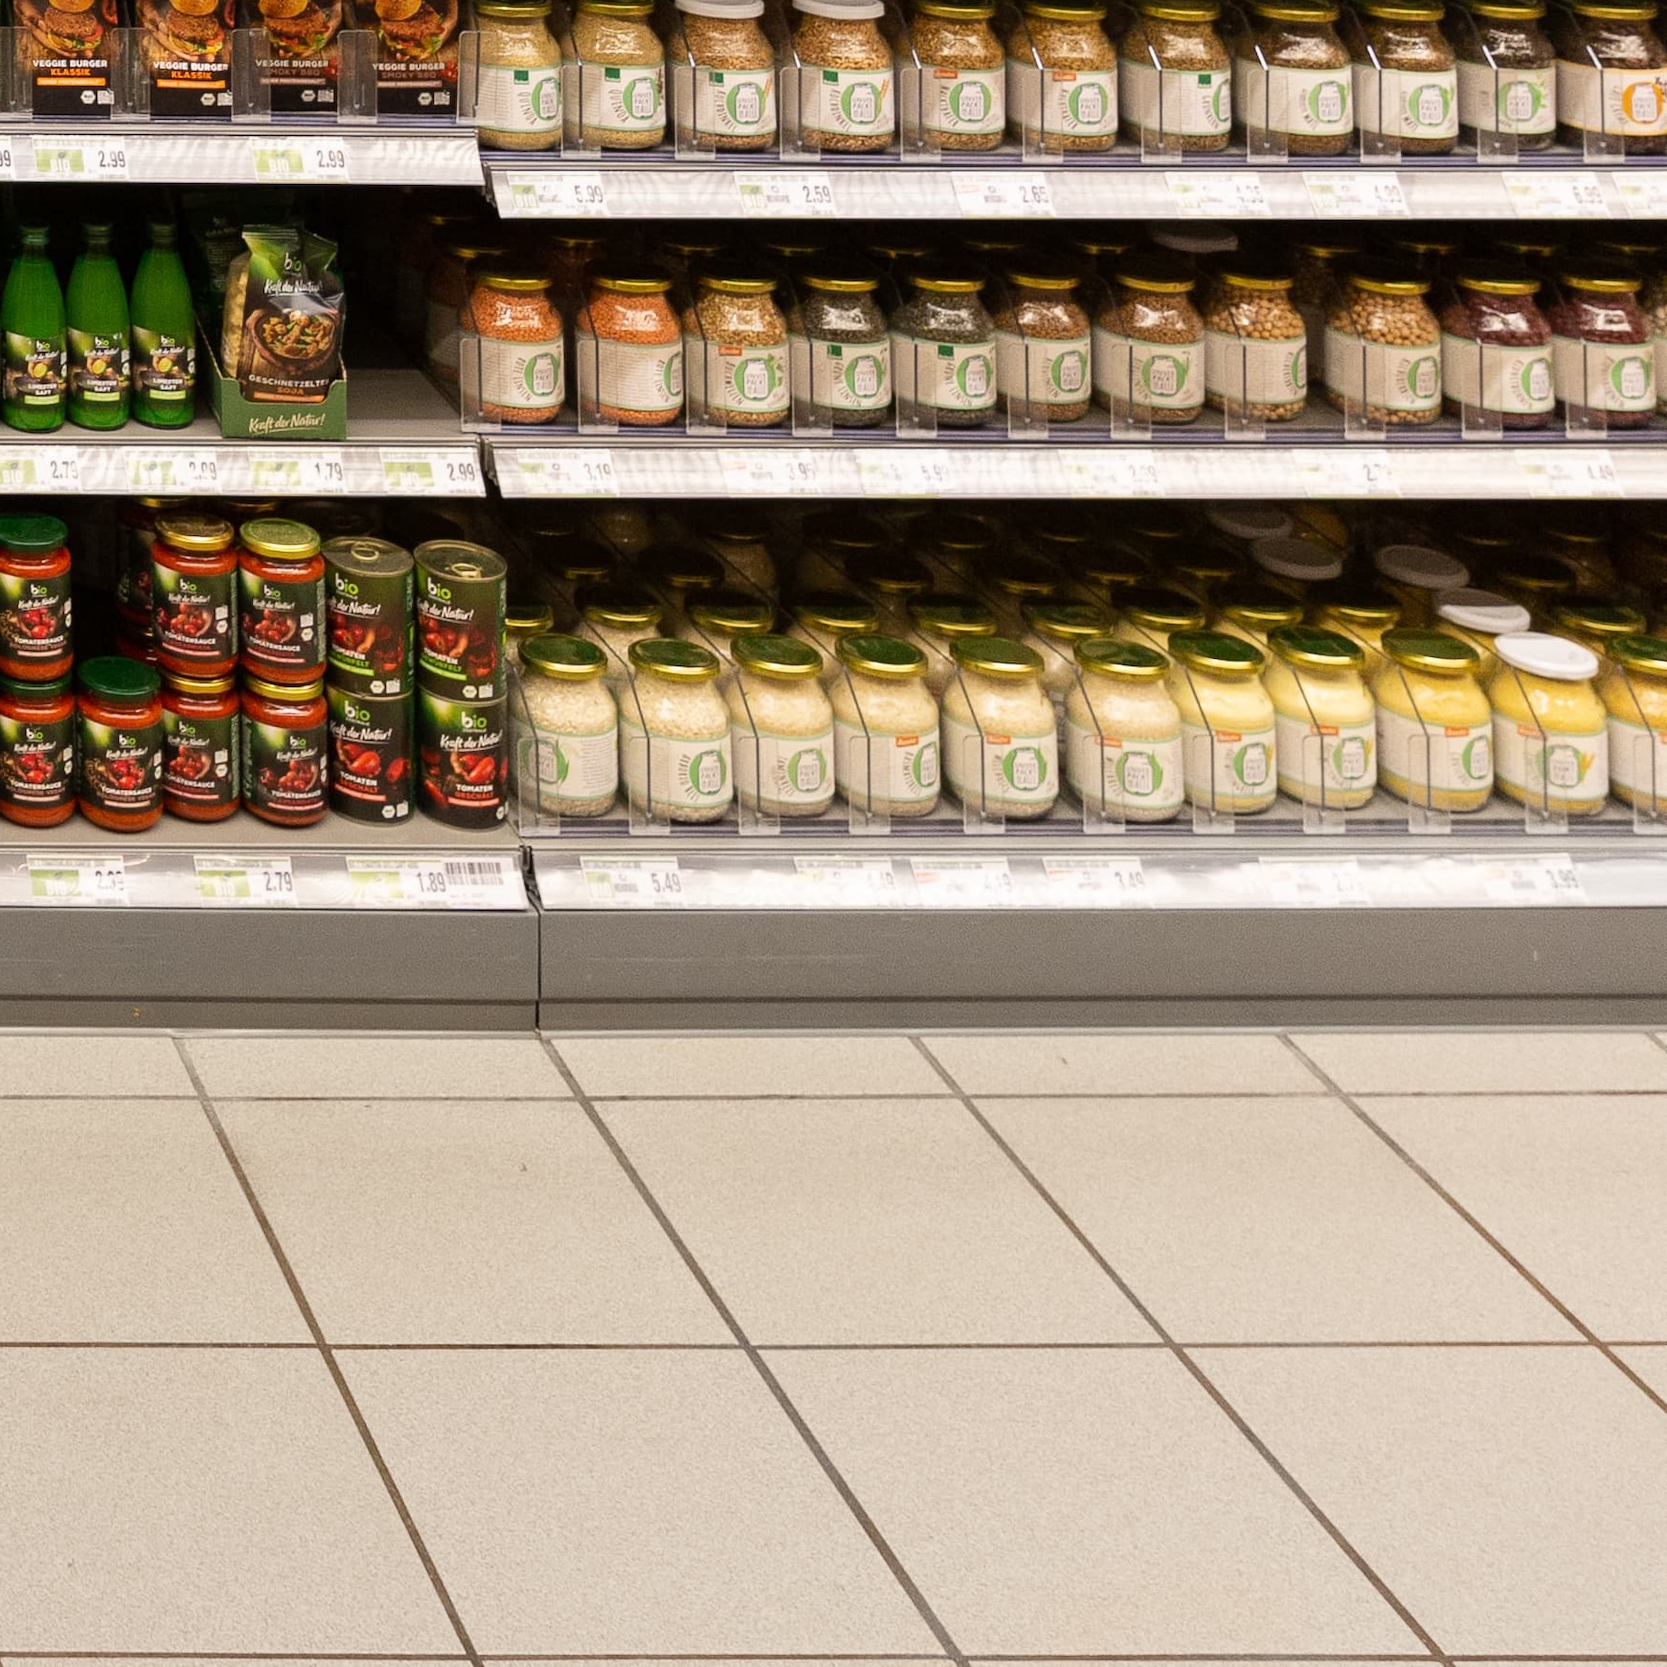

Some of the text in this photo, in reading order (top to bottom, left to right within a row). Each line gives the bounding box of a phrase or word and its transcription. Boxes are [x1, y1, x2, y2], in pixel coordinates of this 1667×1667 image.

[33, 59, 108, 68] VEGGIE BURGER
[50, 68, 90, 76] KLASSIK
[802, 185, 831, 204] 2.59
[249, 418, 275, 433] Kraft
[295, 412, 325, 427] Natur!
[264, 873, 292, 891] 2.79
[651, 873, 681, 893] 5.49
